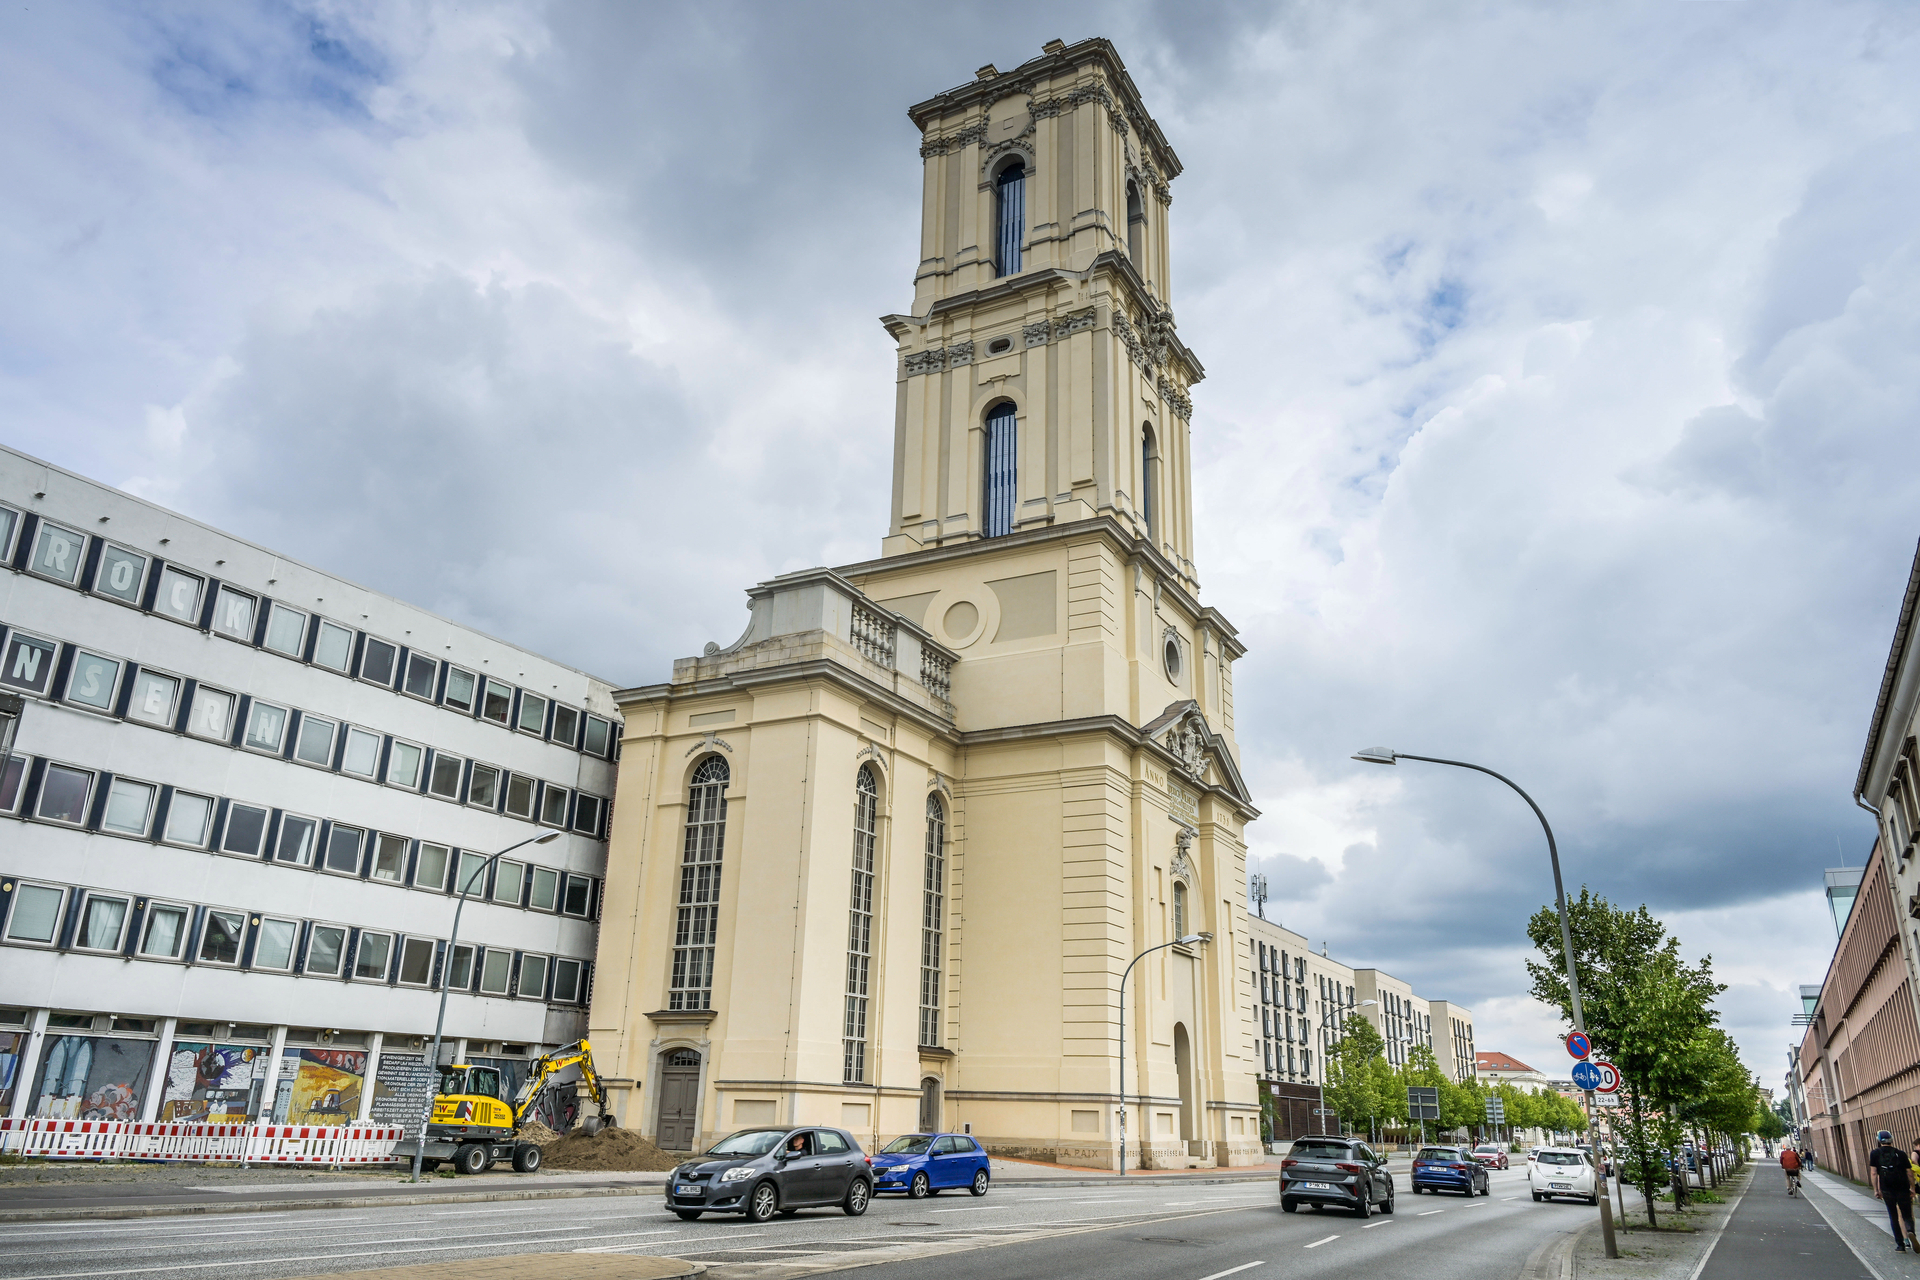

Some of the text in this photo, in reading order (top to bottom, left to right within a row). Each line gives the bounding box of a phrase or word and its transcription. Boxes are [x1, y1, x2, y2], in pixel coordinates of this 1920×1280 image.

[1144, 763, 1164, 788] ANNO
[1043, 1147, 1055, 1156] DE
[1074, 1148, 1098, 1158] PAIX
